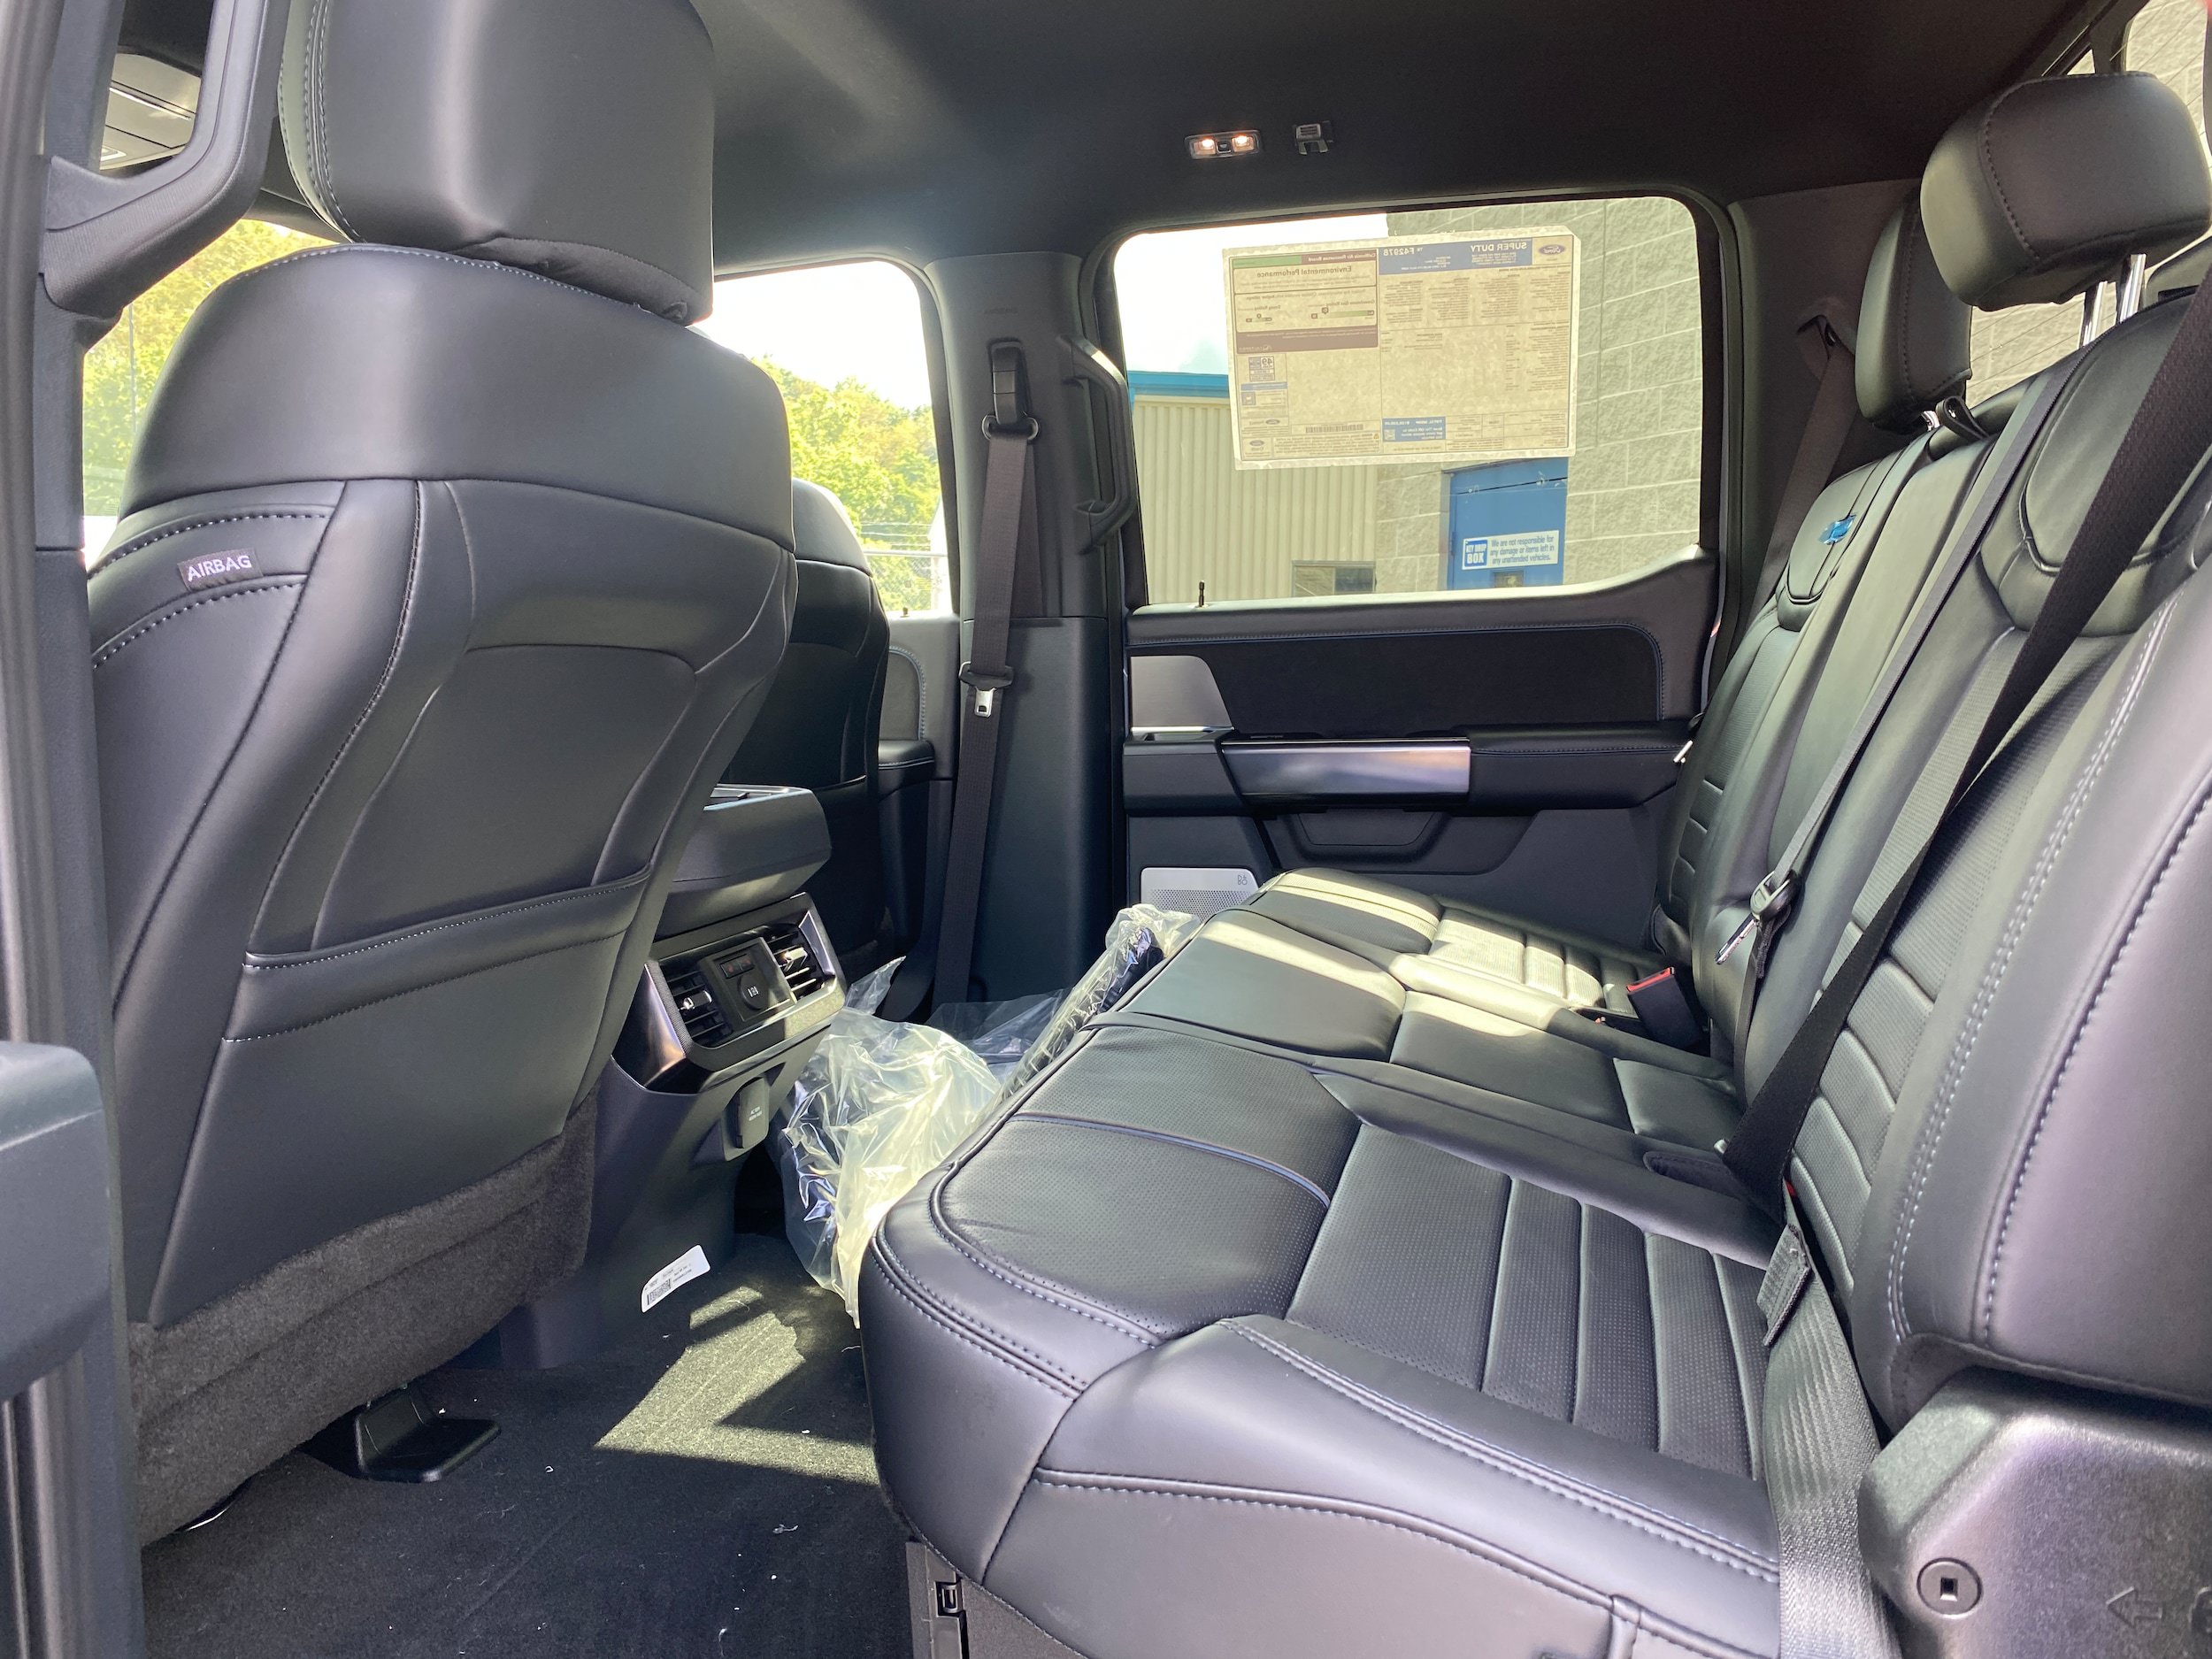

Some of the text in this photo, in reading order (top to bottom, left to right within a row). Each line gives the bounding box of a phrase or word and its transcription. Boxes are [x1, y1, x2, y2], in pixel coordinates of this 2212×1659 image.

[1517, 537, 1546, 547] responsible
[1499, 548, 1518, 557] damage
[1467, 552, 1485, 564] BOX
[1502, 555, 1529, 564] unattended
[188, 555, 252, 582] AIRBAG
